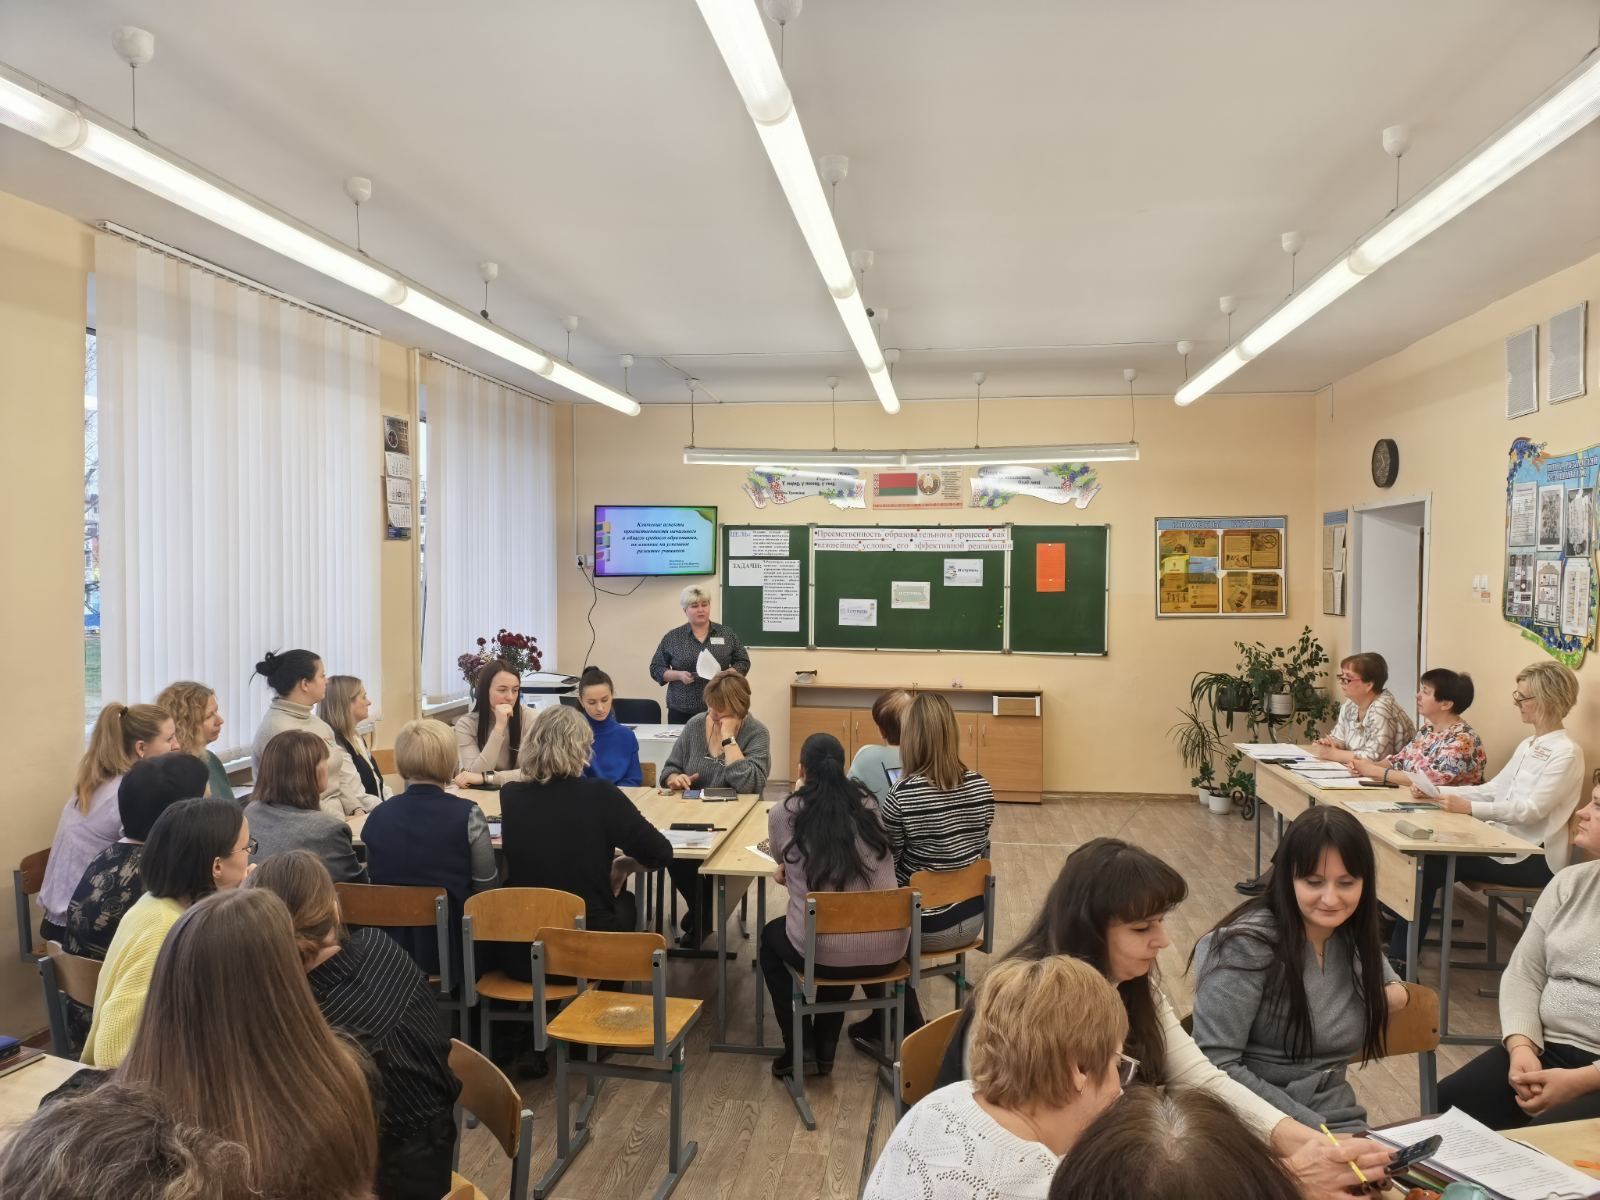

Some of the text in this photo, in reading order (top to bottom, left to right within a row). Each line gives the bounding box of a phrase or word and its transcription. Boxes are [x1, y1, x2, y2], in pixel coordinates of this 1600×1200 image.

[817, 530, 882, 538] Преемственность
[884, 530, 953, 539] образовательного
[954, 532, 990, 540] процесса
[816, 541, 1013, 551] важнейшее условие его эффективной реализации
